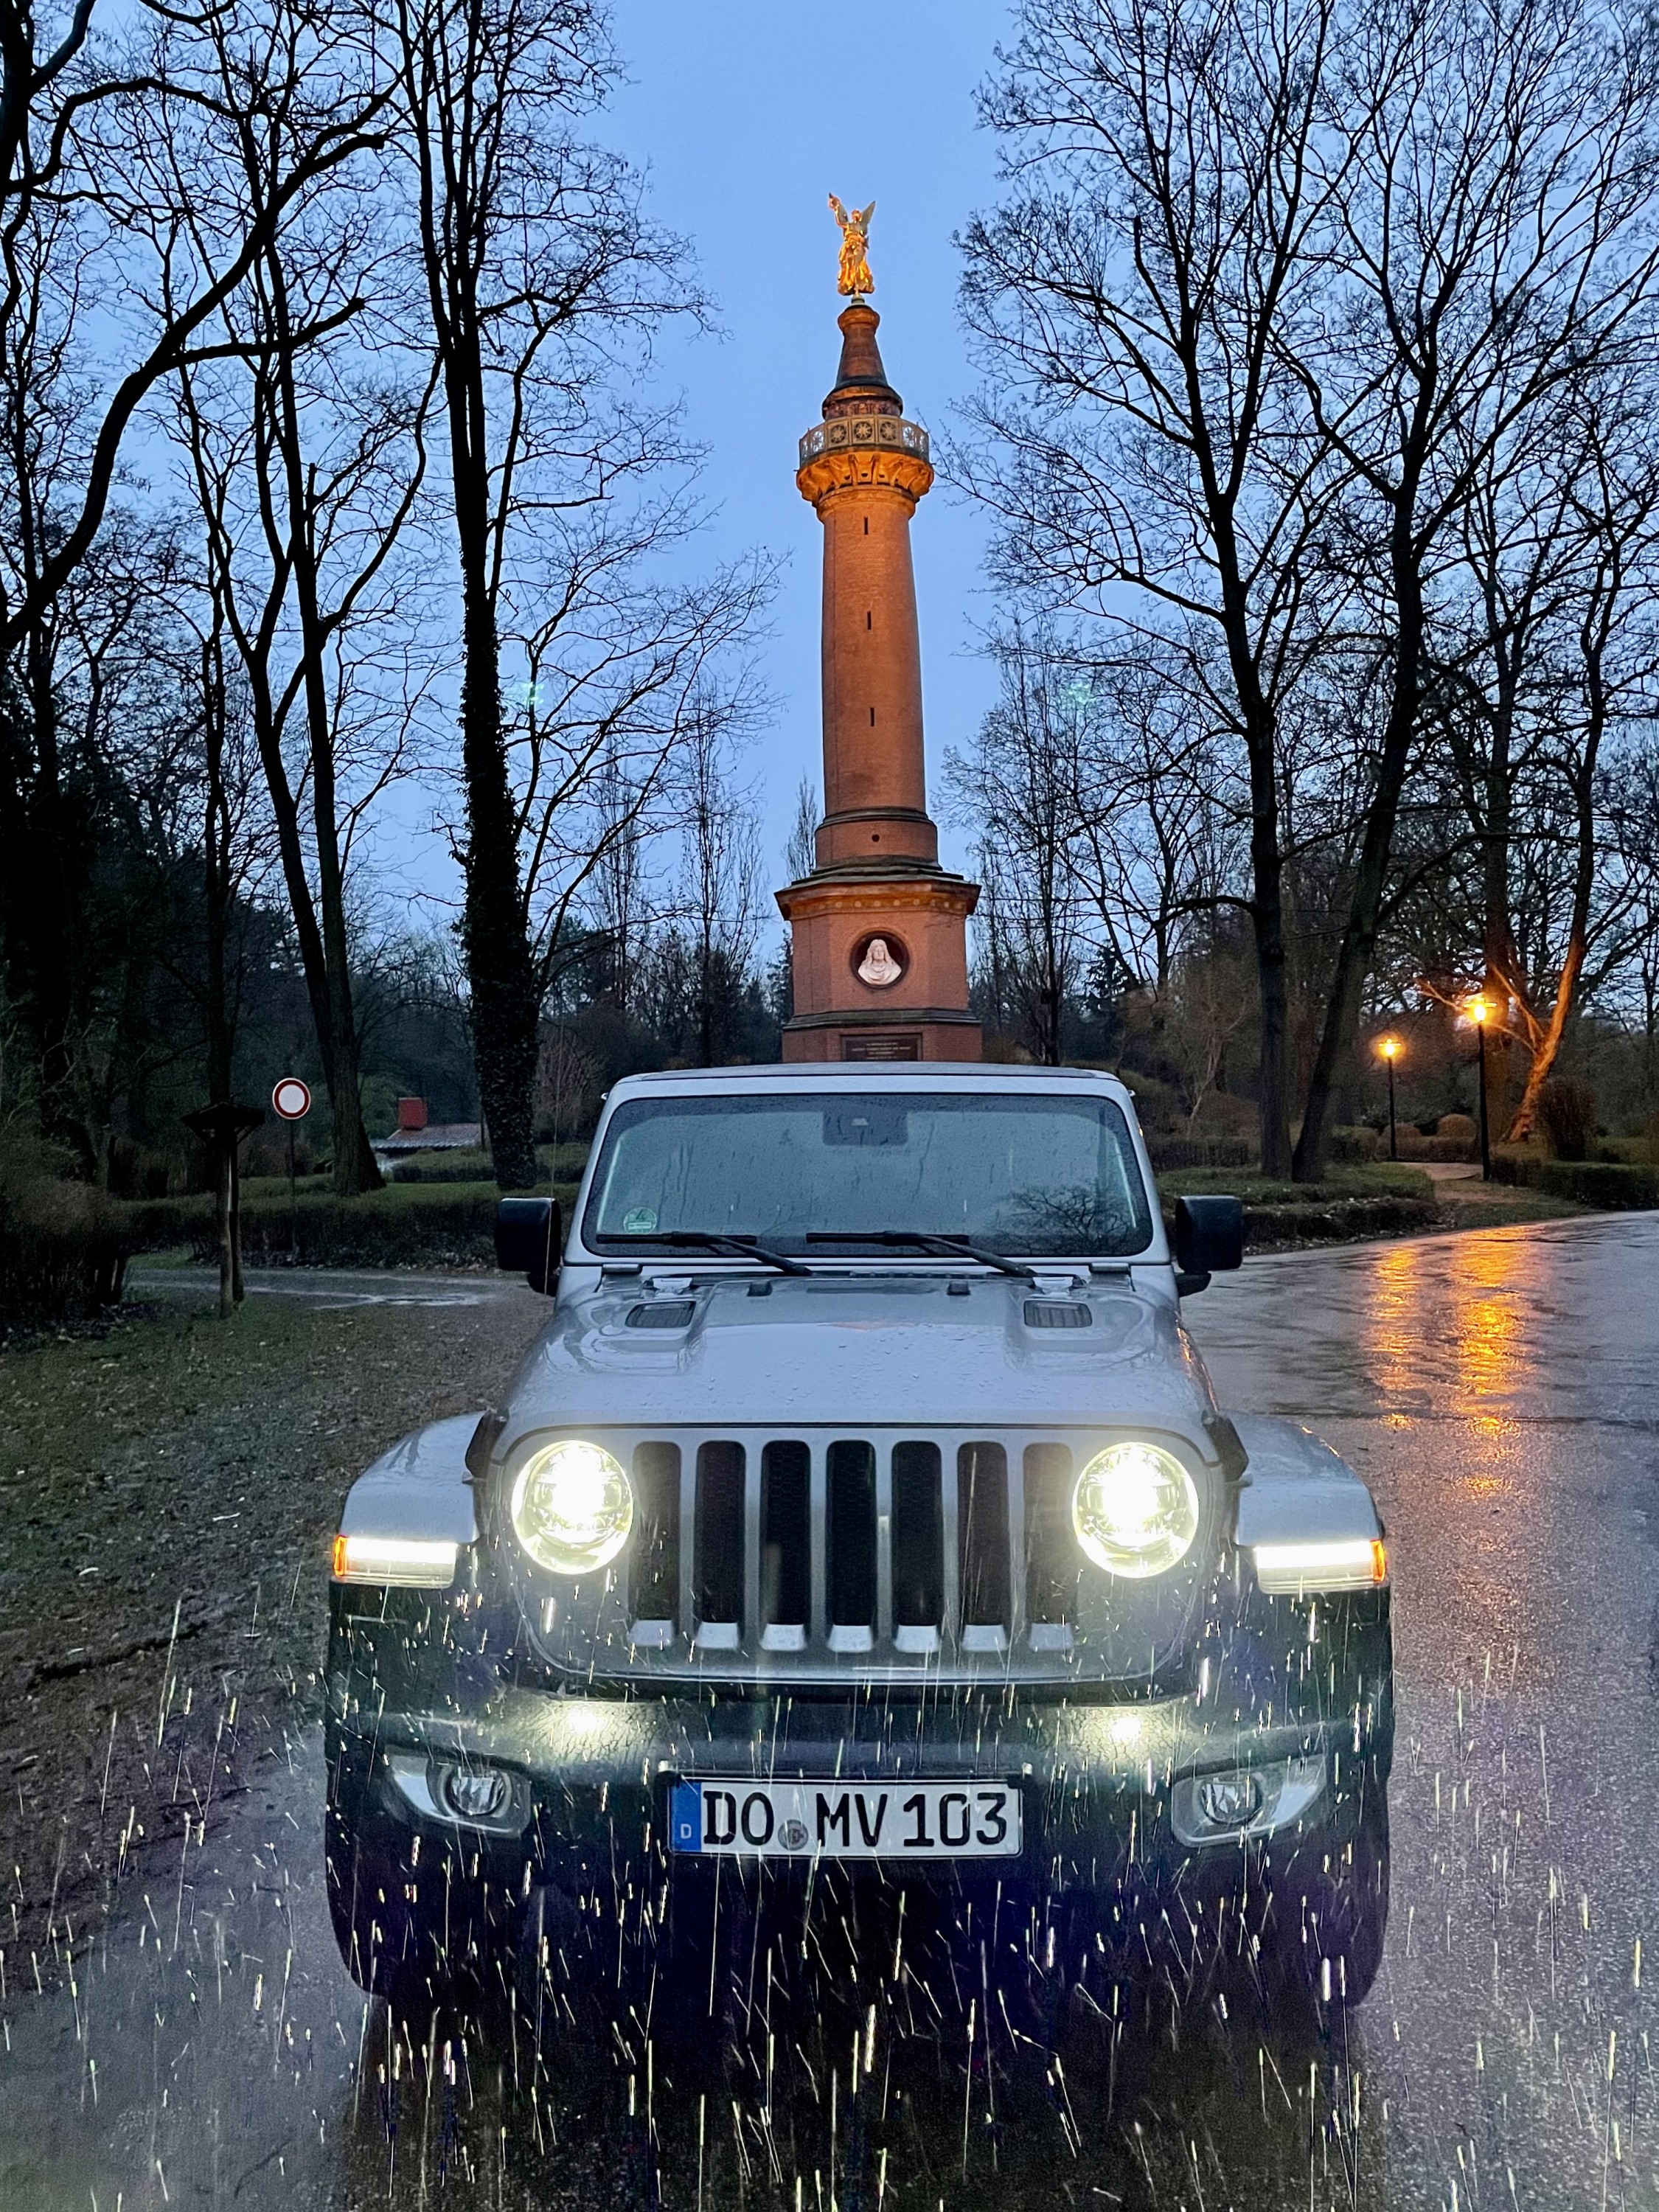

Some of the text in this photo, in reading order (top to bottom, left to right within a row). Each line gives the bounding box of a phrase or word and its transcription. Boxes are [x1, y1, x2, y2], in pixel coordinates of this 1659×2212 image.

[680, 1823, 692, 1840] D
[703, 1790, 1007, 1847] DO MV 103
